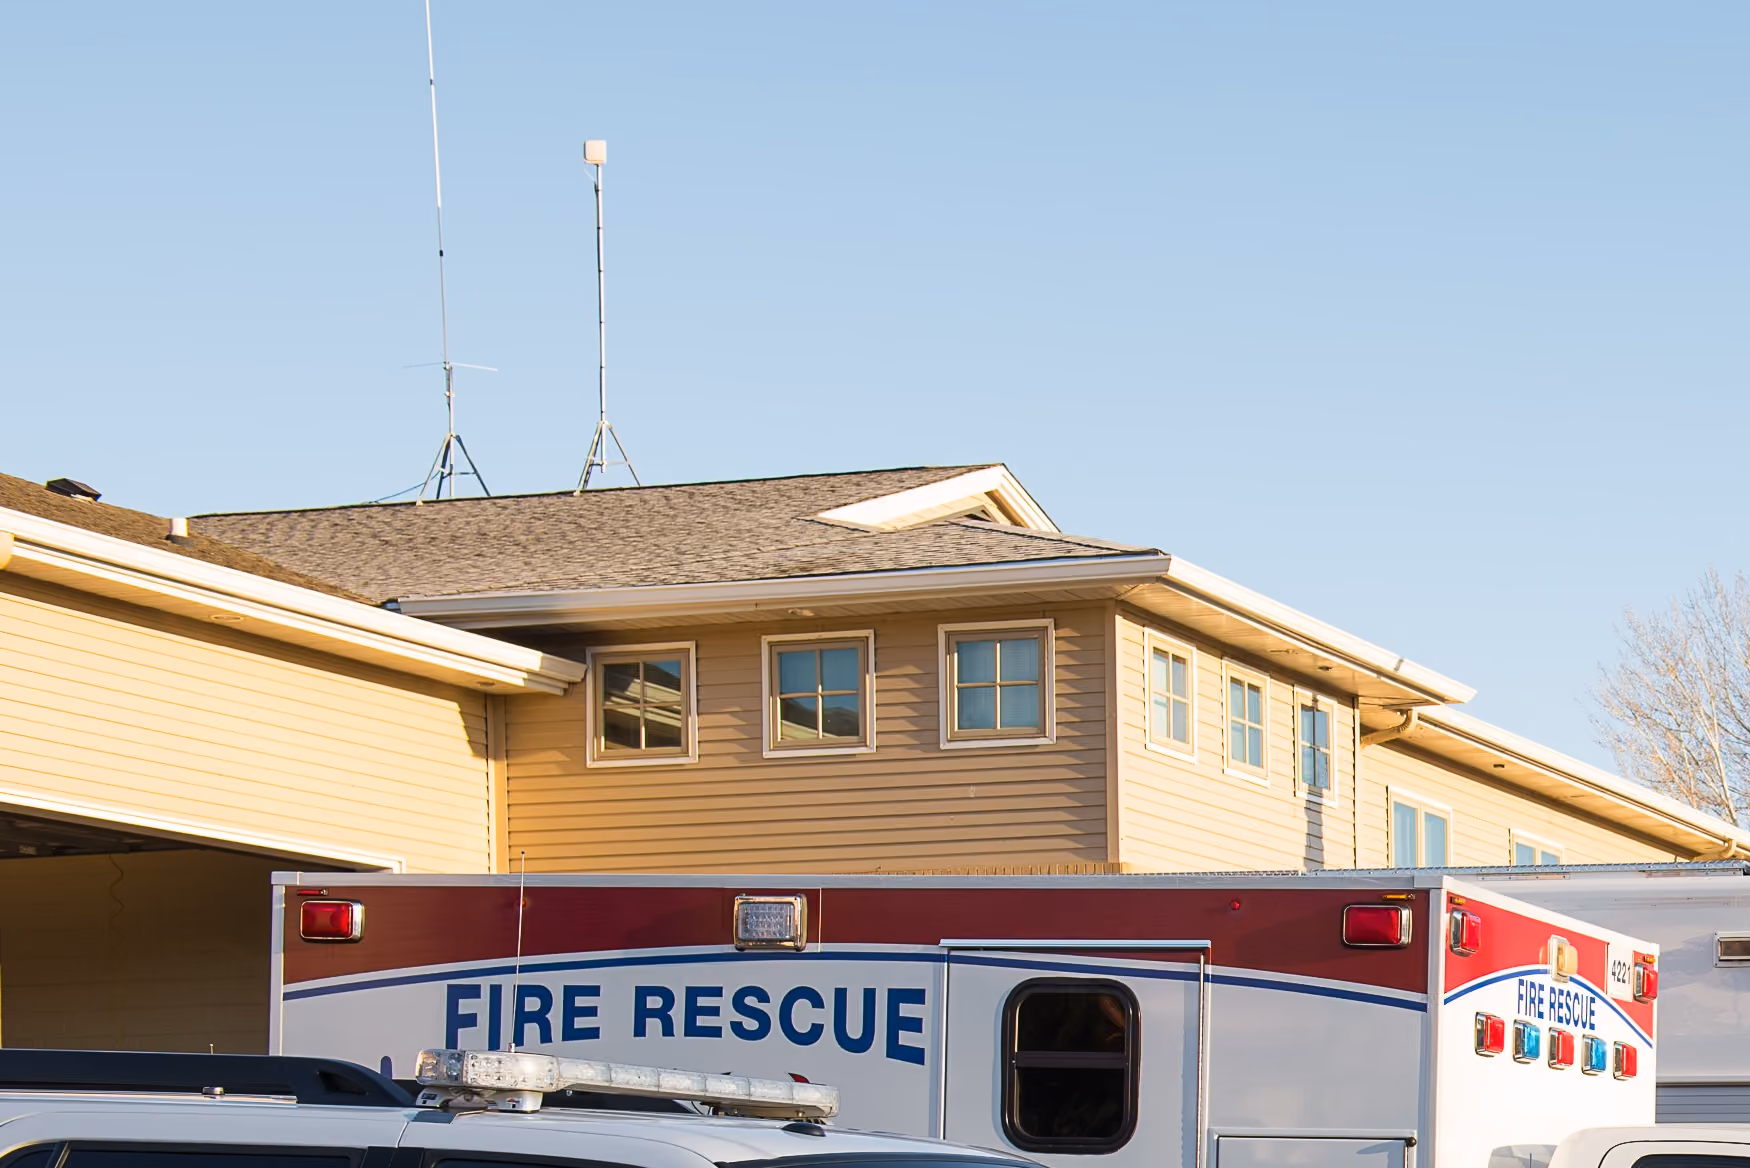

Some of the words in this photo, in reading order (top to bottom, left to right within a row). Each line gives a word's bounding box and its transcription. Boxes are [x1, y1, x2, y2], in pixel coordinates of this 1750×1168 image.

[1611, 959, 1631, 985] 4221
[445, 983, 601, 1050] FIRE
[633, 985, 926, 1065] RESCUE
[1517, 978, 1545, 1020] FIRE
[1548, 985, 1596, 1031] RESCUE
